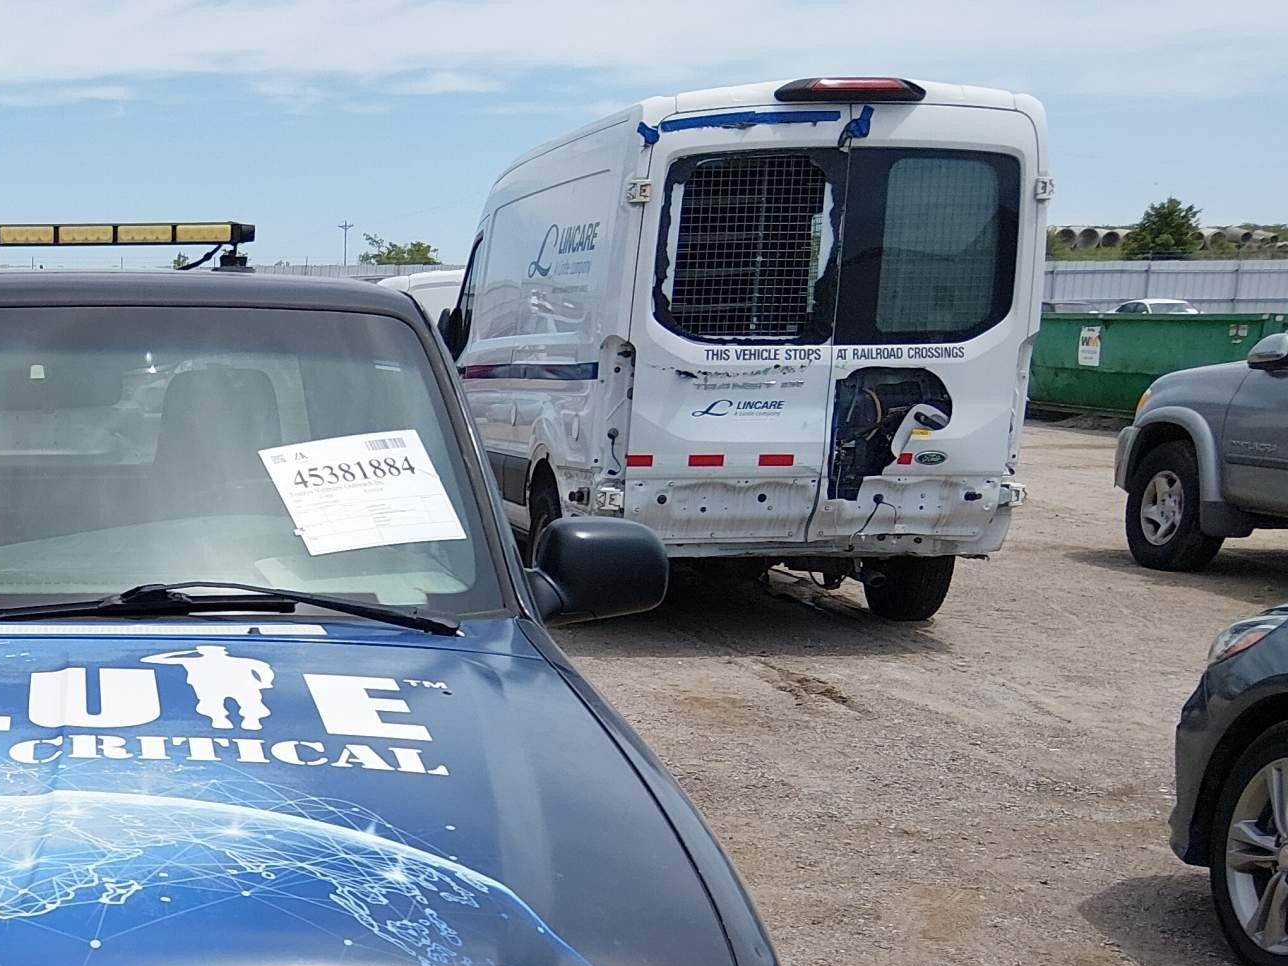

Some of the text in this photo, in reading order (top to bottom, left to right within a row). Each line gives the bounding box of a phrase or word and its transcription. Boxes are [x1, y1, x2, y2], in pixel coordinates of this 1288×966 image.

[558, 221, 601, 255] LINCARE
[704, 346, 965, 361] THIS VEHICLE STOPS AT RAILROAD CROSSINGS
[735, 399, 785, 410] LINCARE
[293, 455, 416, 489] 45381884
[8, 734, 450, 777] CRITICAL
